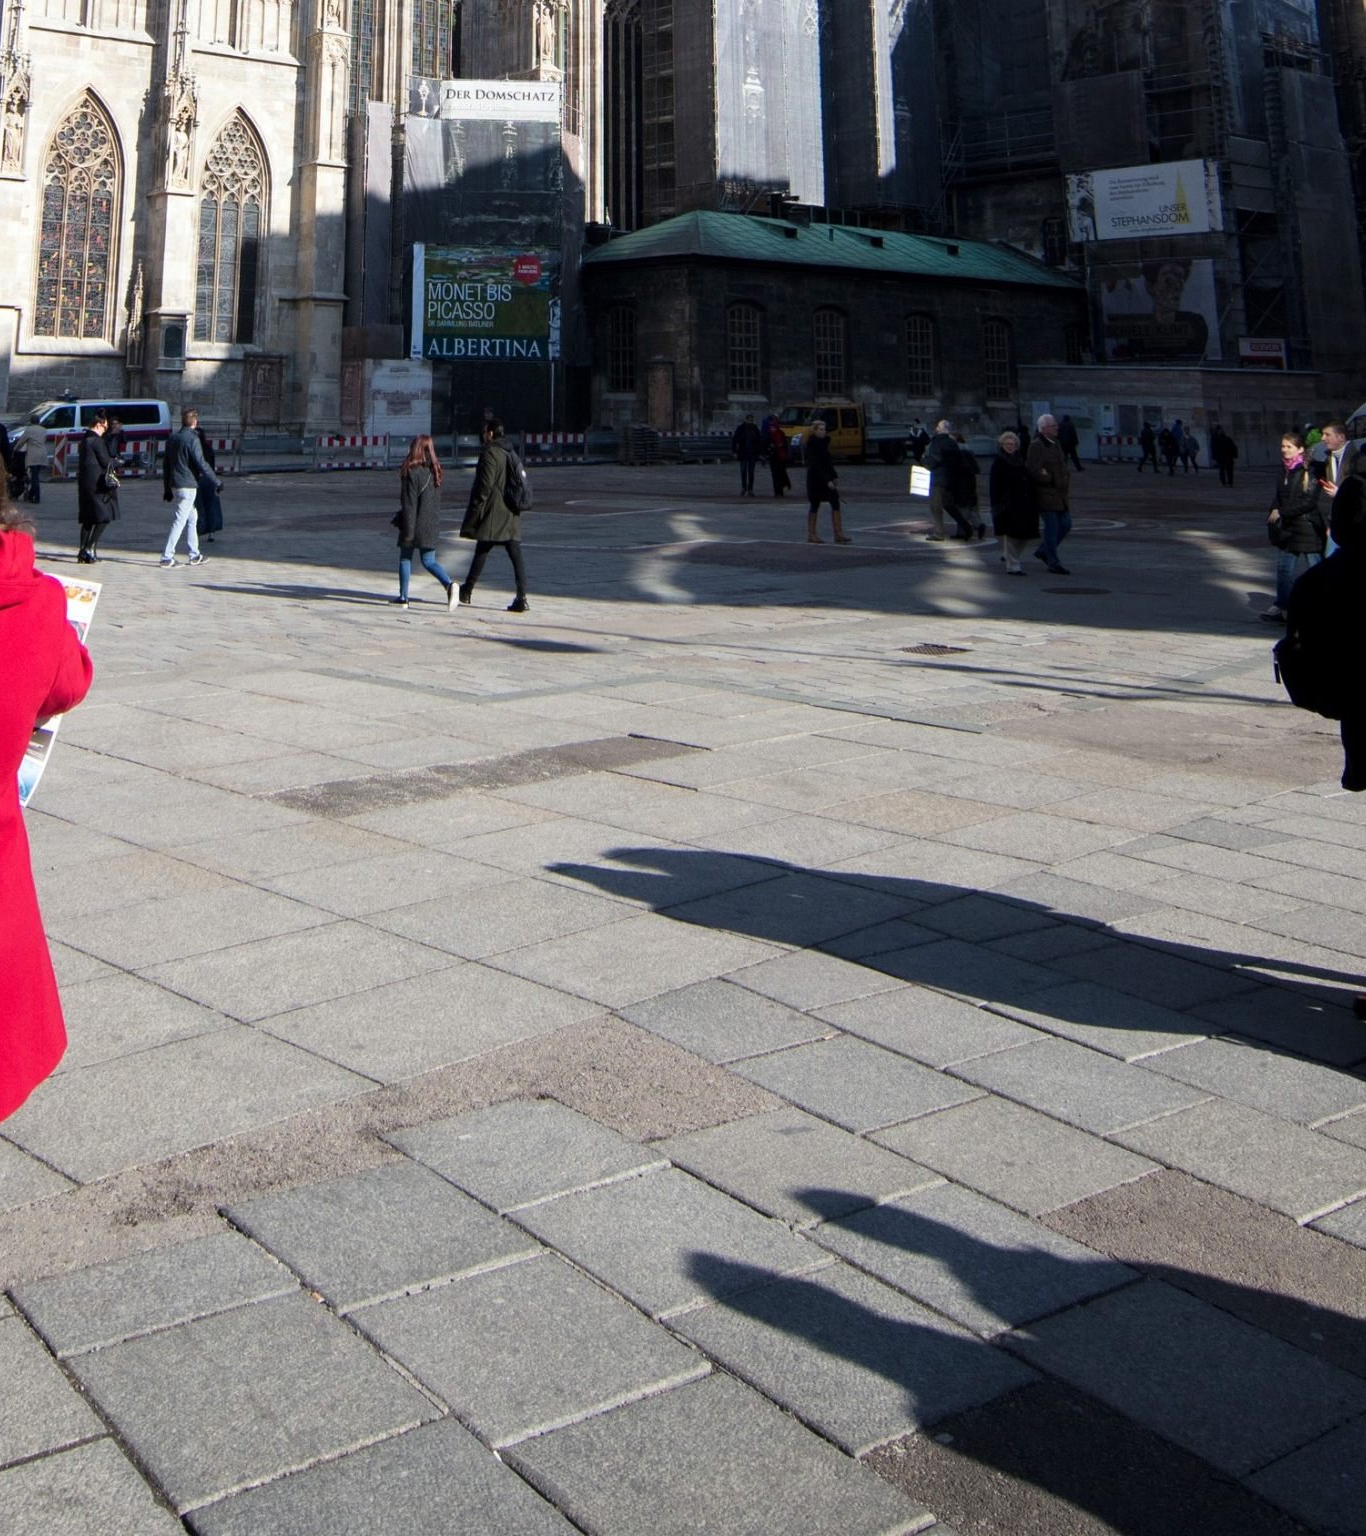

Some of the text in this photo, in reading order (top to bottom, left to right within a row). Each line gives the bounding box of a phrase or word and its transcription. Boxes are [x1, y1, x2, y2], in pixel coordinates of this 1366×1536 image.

[446, 88, 556, 102] DER DOMSCHATZ
[1159, 203, 1188, 213] UNSER
[1111, 212, 1190, 227] STEPHANSDOM
[428, 282, 512, 302] MONET BIS
[427, 301, 495, 320] PICASSO
[428, 337, 541, 358] ALBERTINA
